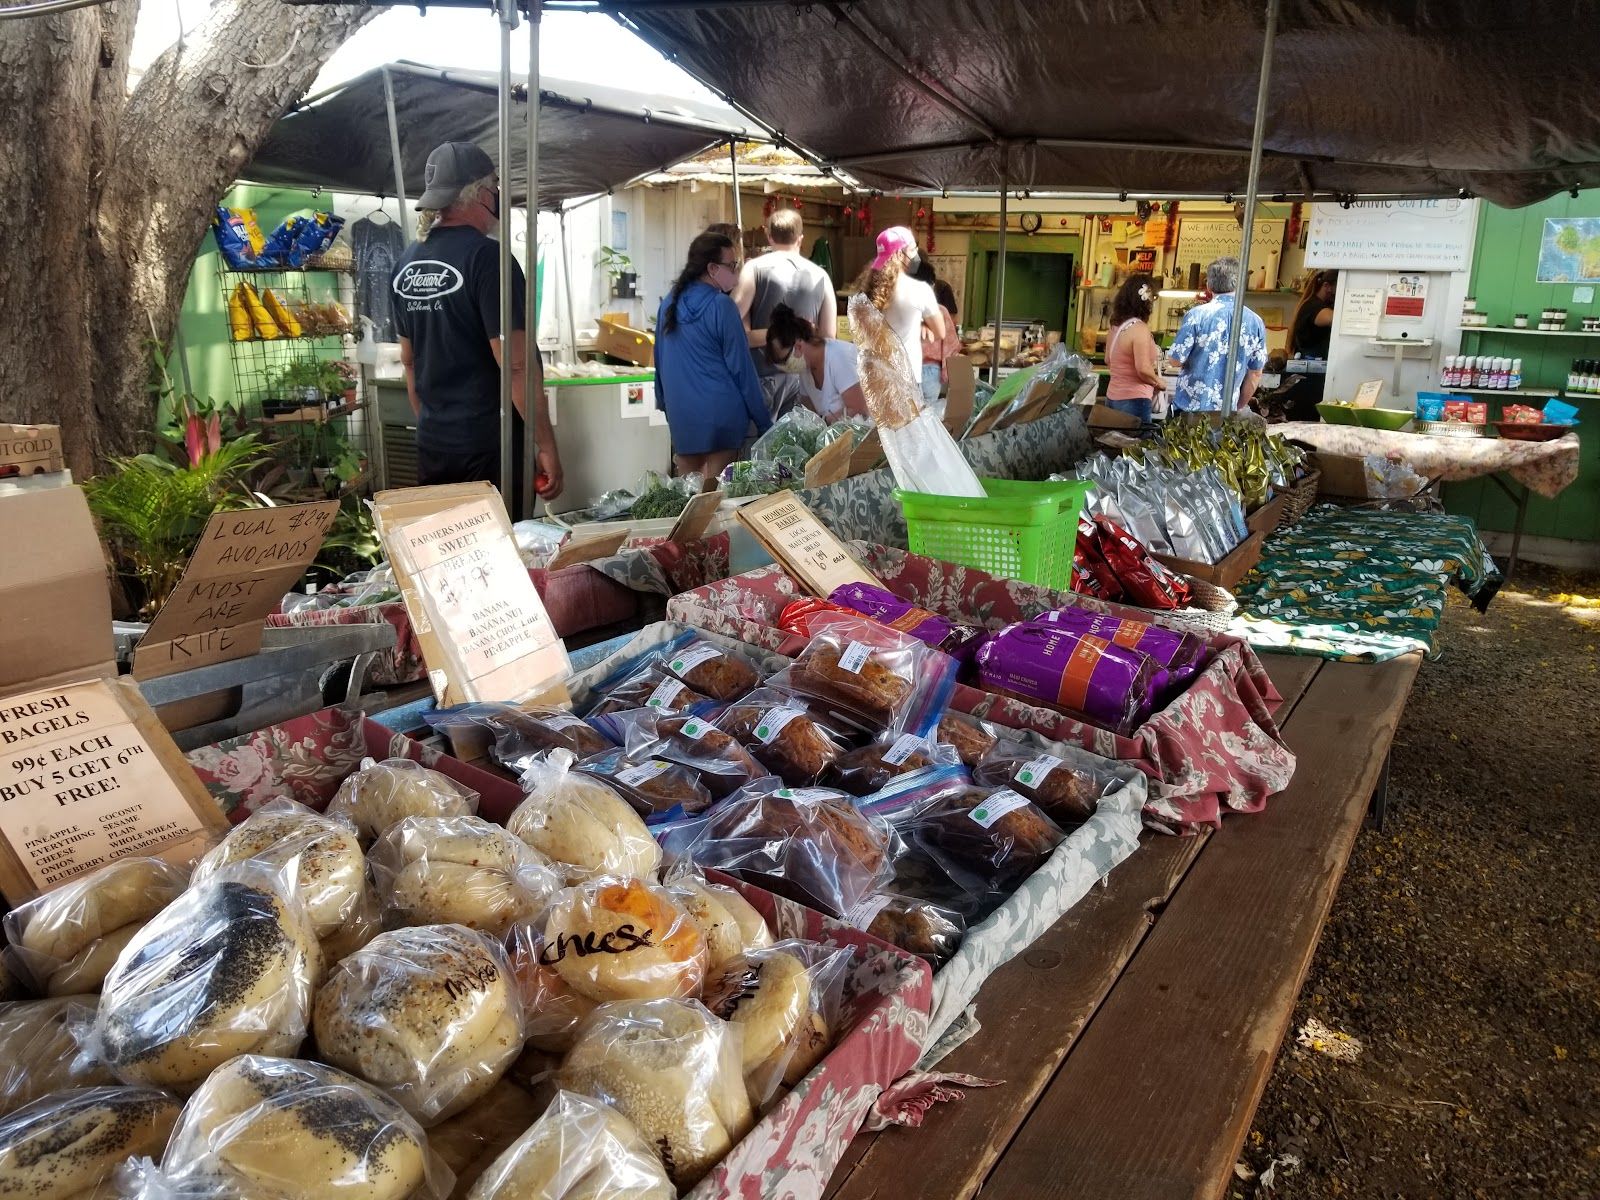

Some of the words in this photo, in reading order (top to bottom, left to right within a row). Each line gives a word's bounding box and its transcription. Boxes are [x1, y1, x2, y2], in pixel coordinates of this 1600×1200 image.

[402, 268, 450, 292] Stewart
[13, 439, 53, 455] GOLD
[761, 503, 796, 522] HOMEMAID
[775, 513, 801, 530] BAKERY
[213, 519, 277, 541] LOCAL
[410, 526, 455, 548] FARMERS
[455, 512, 493, 532] MARKET
[789, 527, 807, 539] LOCAL
[217, 535, 316, 565] AVOCADOS
[438, 532, 479, 555] SWEET
[803, 541, 820, 553] BREAD
[187, 579, 265, 604] MOST
[193, 601, 248, 624] ARE
[469, 616, 506, 638] BANANA
[505, 607, 524, 623] NUT
[472, 600, 510, 621] BANANA
[169, 627, 236, 661] RIPE
[462, 634, 496, 655] BANANA
[483, 629, 531, 659] PINEAPPLE
[1043, 635, 1060, 656] HOME
[0, 695, 71, 724] FRESH
[1, 711, 90, 744] BAGELS
[11, 753, 48, 774] 99¢
[50, 735, 114, 762] EACH
[0, 775, 46, 803] BUY
[52, 771, 64, 785] 5
[68, 756, 114, 779] GET
[53, 776, 121, 807] FREE!
[98, 803, 144, 824] COCONUT
[103, 815, 140, 831] SESAME
[25, 825, 81, 850] PINEAPPLE
[30, 829, 96, 859] EVERYTHING
[108, 825, 137, 840] PLAIN
[109, 832, 144, 848] WHOLE
[145, 821, 178, 837] WHEAT
[109, 836, 159, 859] CINNAMON
[160, 826, 190, 842] RAISIN
[36, 846, 76, 867] CHEESE
[41, 857, 75, 876] ONION
[46, 855, 105, 884] BLUEBERRY
